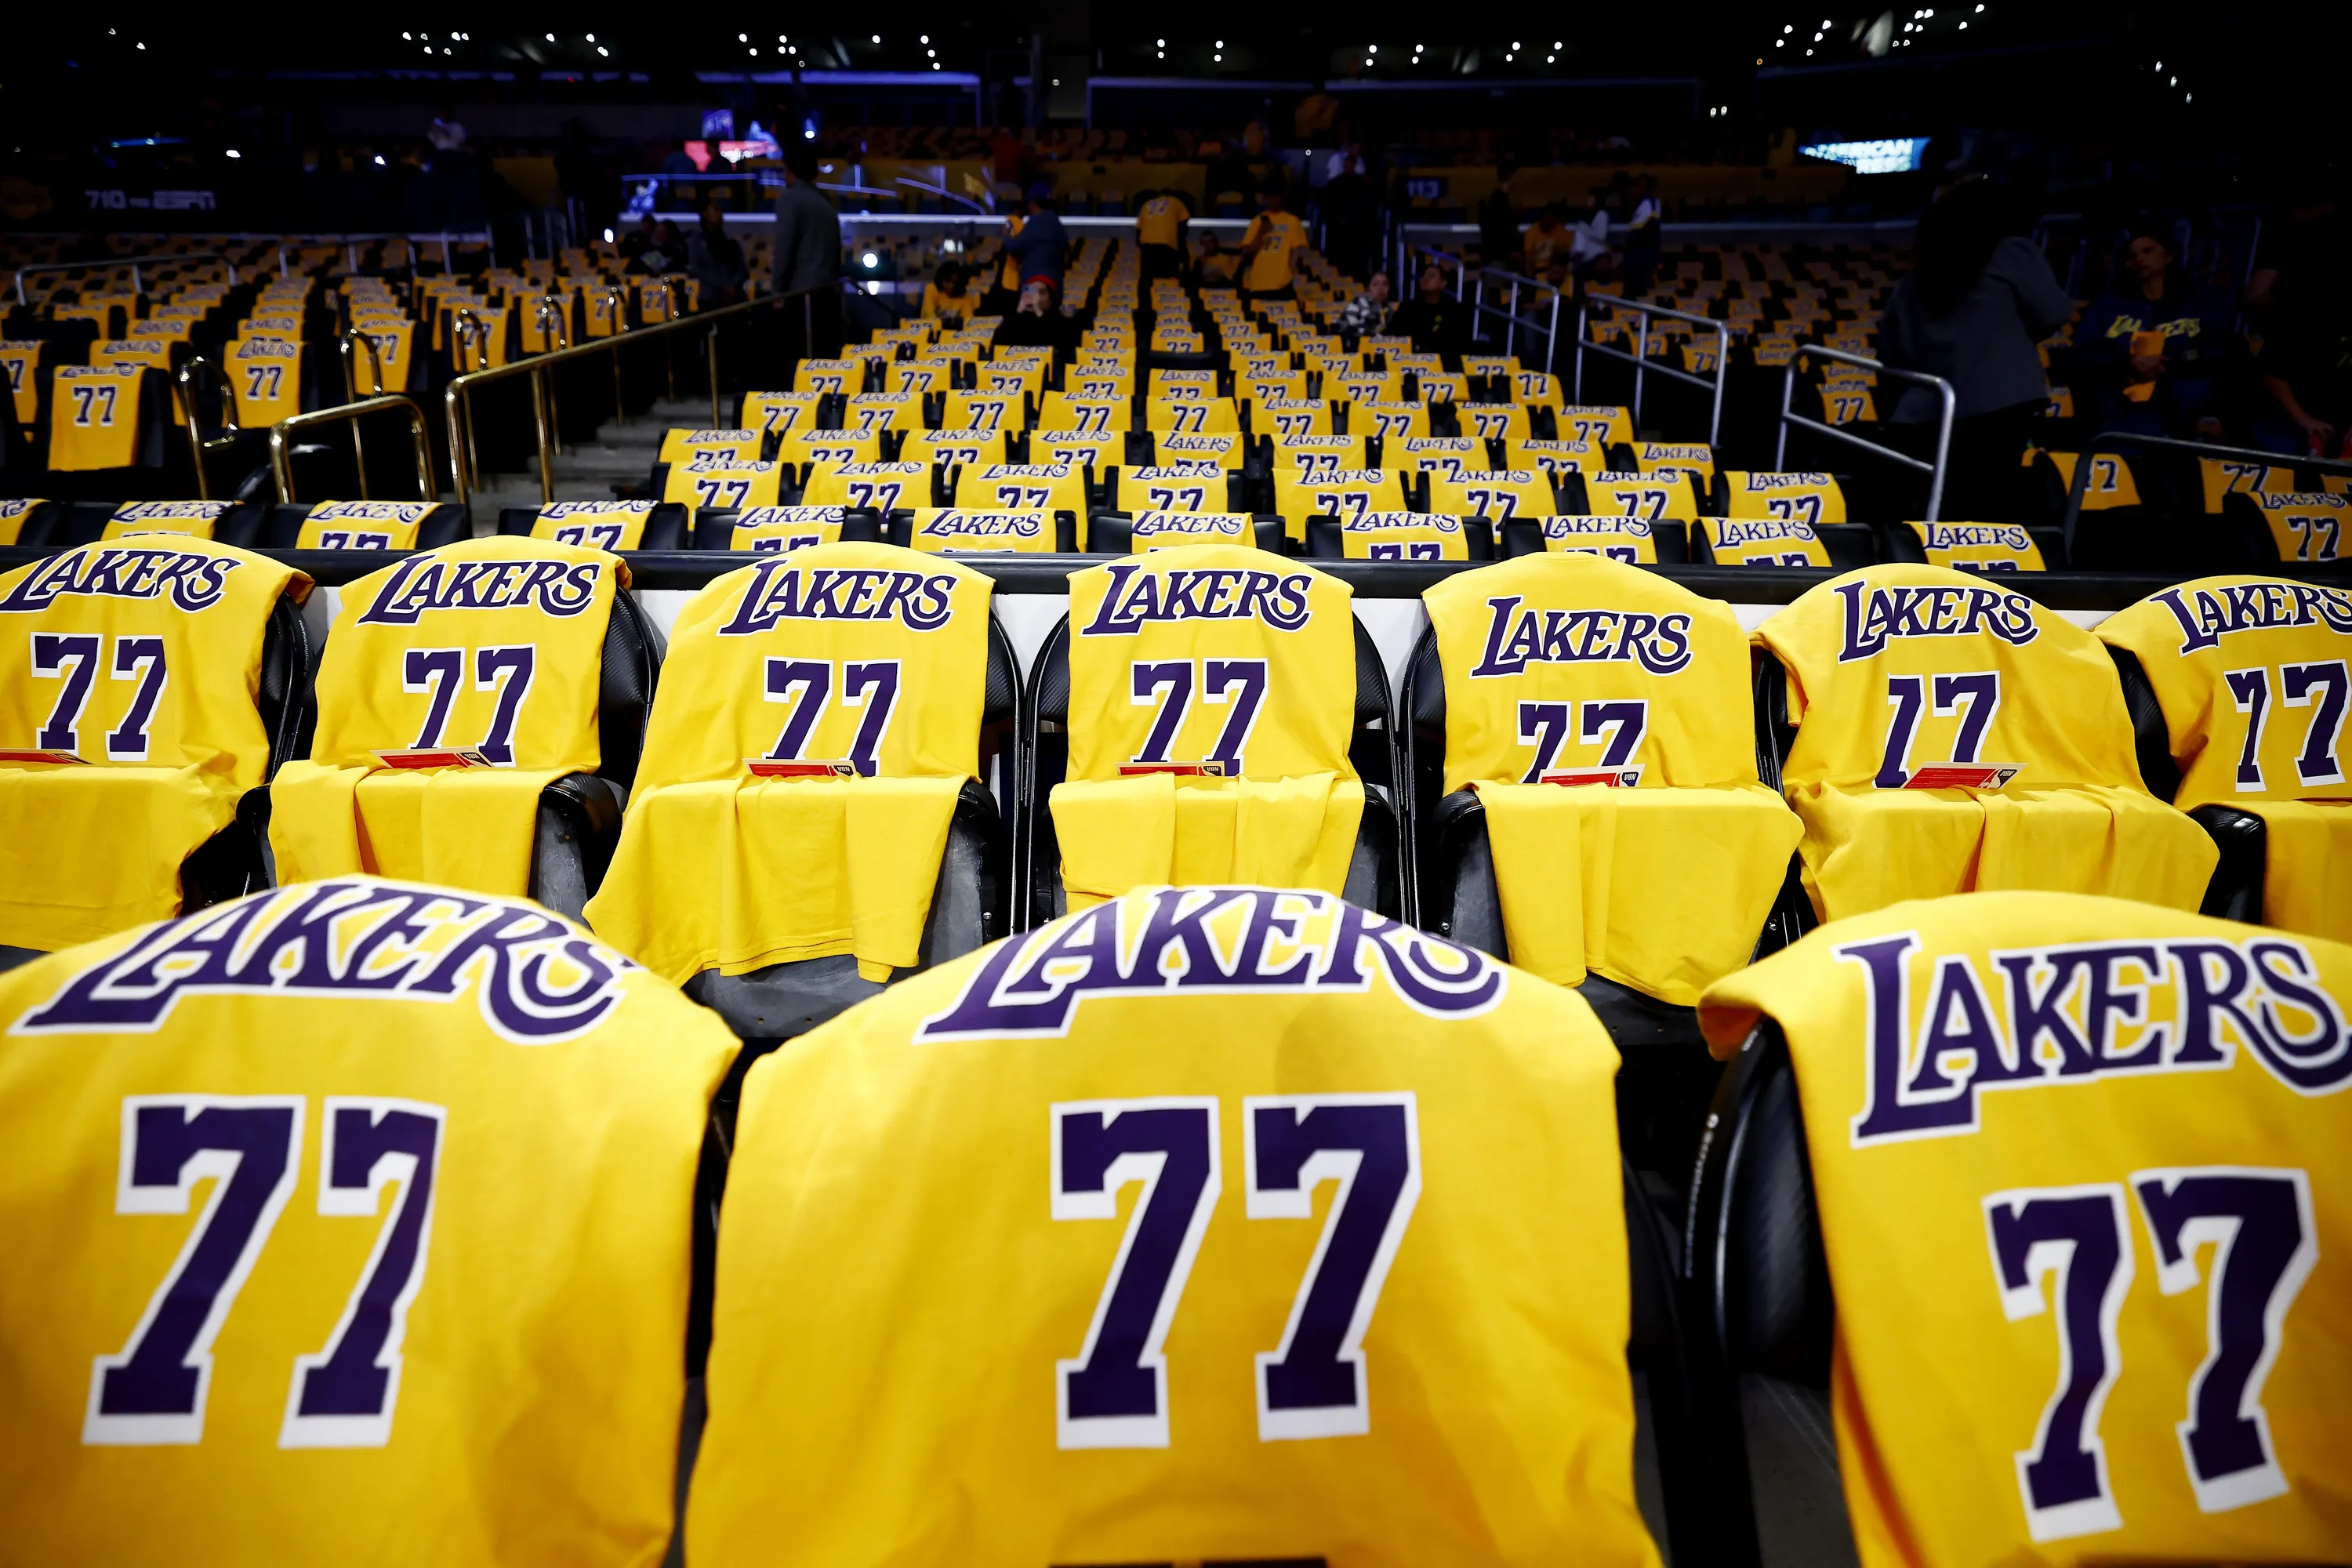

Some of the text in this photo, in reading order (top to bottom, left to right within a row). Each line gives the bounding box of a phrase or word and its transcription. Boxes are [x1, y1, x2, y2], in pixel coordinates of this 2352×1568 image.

[85, 191, 126, 209] 710
[0, 358, 25, 393] 7
[246, 365, 284, 401] 77
[1518, 372, 1550, 398] 77
[73, 385, 117, 427] 77
[762, 405, 803, 430] 77
[857, 408, 896, 430] 77
[967, 401, 1007, 430] 77
[1073, 405, 1112, 431] 77
[1170, 405, 1210, 432] 77
[1833, 396, 1867, 425] 77
[681, 430, 757, 445] LAKERS
[1275, 413, 1314, 435] 77
[1374, 413, 1414, 437] 77
[1473, 413, 1512, 440] 77
[1573, 419, 1612, 443] 77
[1161, 432, 1233, 452] LAKERS
[1642, 441, 1713, 462] LAKERS
[978, 463, 1071, 480] LAKERS
[1296, 467, 1386, 486] LAKERS
[1745, 470, 1831, 492] LAKERS
[2223, 463, 2271, 494] 77
[695, 478, 751, 510] 77
[1614, 488, 1669, 521] 77
[1766, 492, 1824, 524] 77
[2259, 492, 2347, 510] LAKERS
[306, 500, 436, 524] LAKERS
[735, 506, 847, 528] LAKERS
[918, 507, 1044, 539] LAKERS
[1131, 510, 1244, 537] LAKERS
[1341, 510, 1463, 535] LAKERS
[1543, 516, 1653, 541] LAKERS
[1711, 517, 1817, 550] LAKERS
[1922, 521, 2030, 552] LAKERS
[2285, 515, 2341, 562] 77
[0, 549, 245, 615] LAKERS
[354, 553, 604, 628] LAKERS
[715, 557, 960, 637] LAKERS
[1078, 563, 1316, 637] LAKERS
[1831, 579, 2041, 665] LAKERS
[2148, 583, 2352, 658] LAKERS
[1468, 594, 1695, 680] LAKERS
[30, 631, 169, 761] 77
[402, 642, 537, 768] 77
[762, 655, 902, 778] 77
[1129, 657, 1269, 779] 77
[2223, 659, 2352, 793] 77
[1517, 699, 1649, 785] 77
[1624, 772, 1637, 781] NBA
[5, 877, 651, 1046] LAKERS
[910, 884, 1510, 1045] LAKERS
[1830, 930, 2352, 1151] LAKERS
[81, 1094, 448, 1450] 77
[1050, 1091, 1423, 1450] 77
[1981, 1165, 2321, 1544] 77
